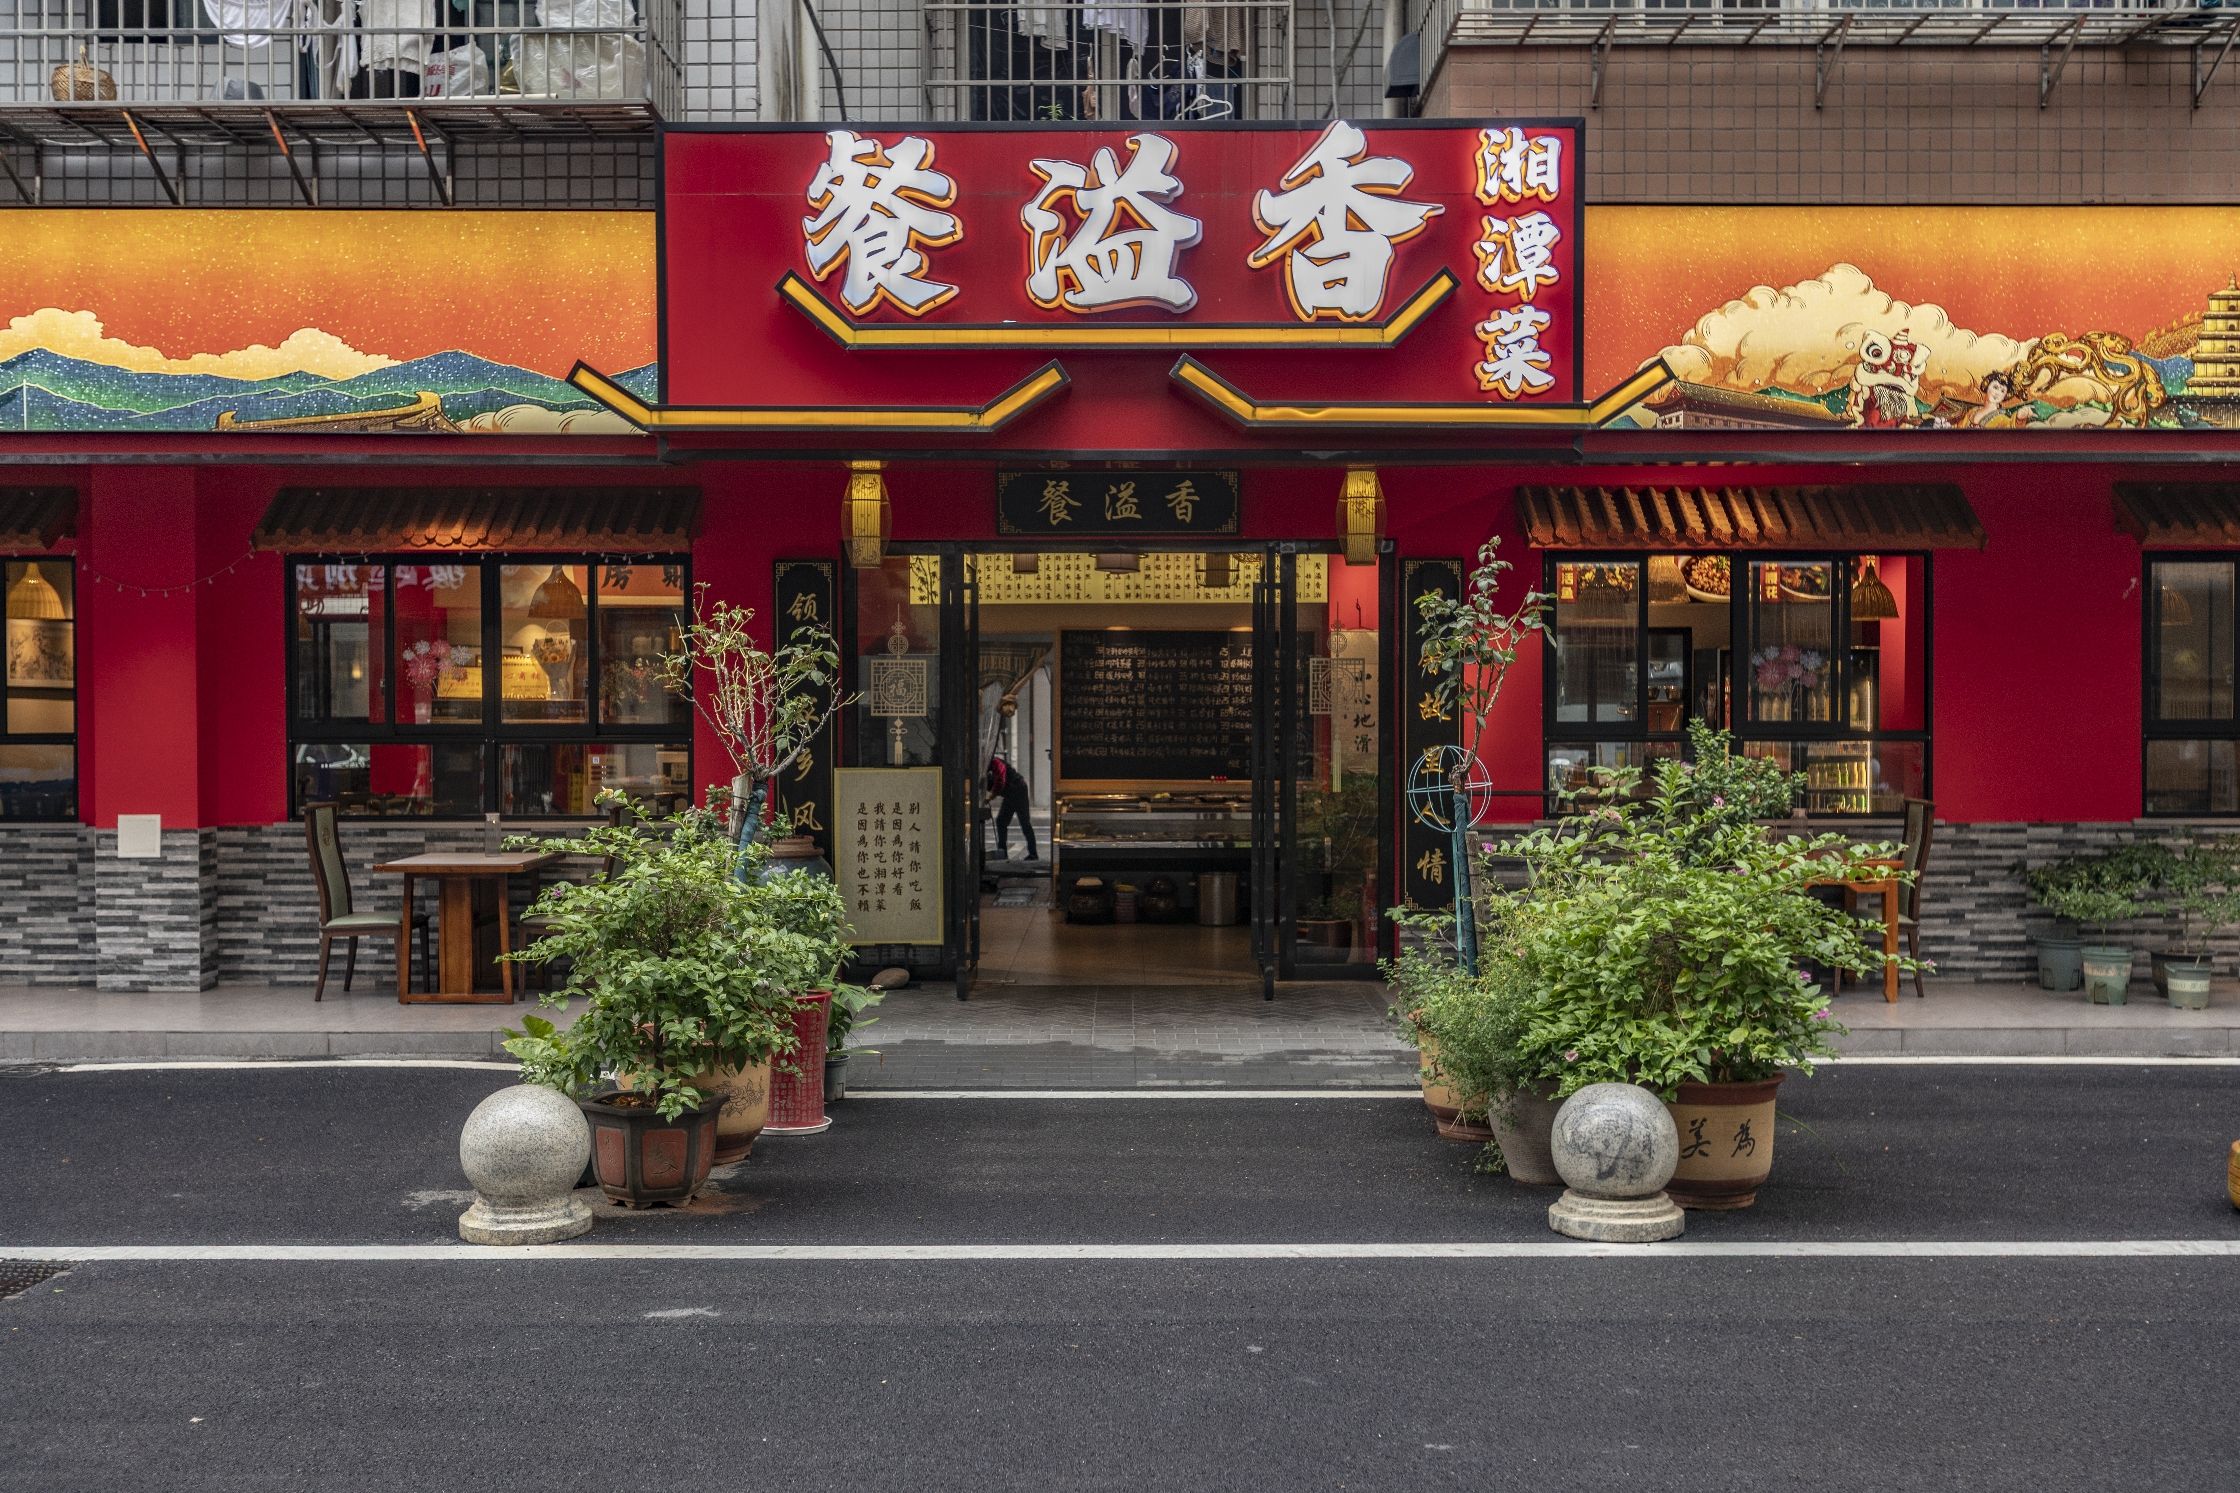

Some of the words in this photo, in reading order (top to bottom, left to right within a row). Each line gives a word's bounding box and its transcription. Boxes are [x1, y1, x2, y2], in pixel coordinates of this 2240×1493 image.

[803, 121, 1446, 322] 餐溢香
[1473, 127, 1561, 399] 湘潭菜
[1036, 479, 1200, 526] 餐溢香
[1353, 670, 1376, 753] 小心地滑
[874, 802, 887, 912] 我請你吃湘潭菜
